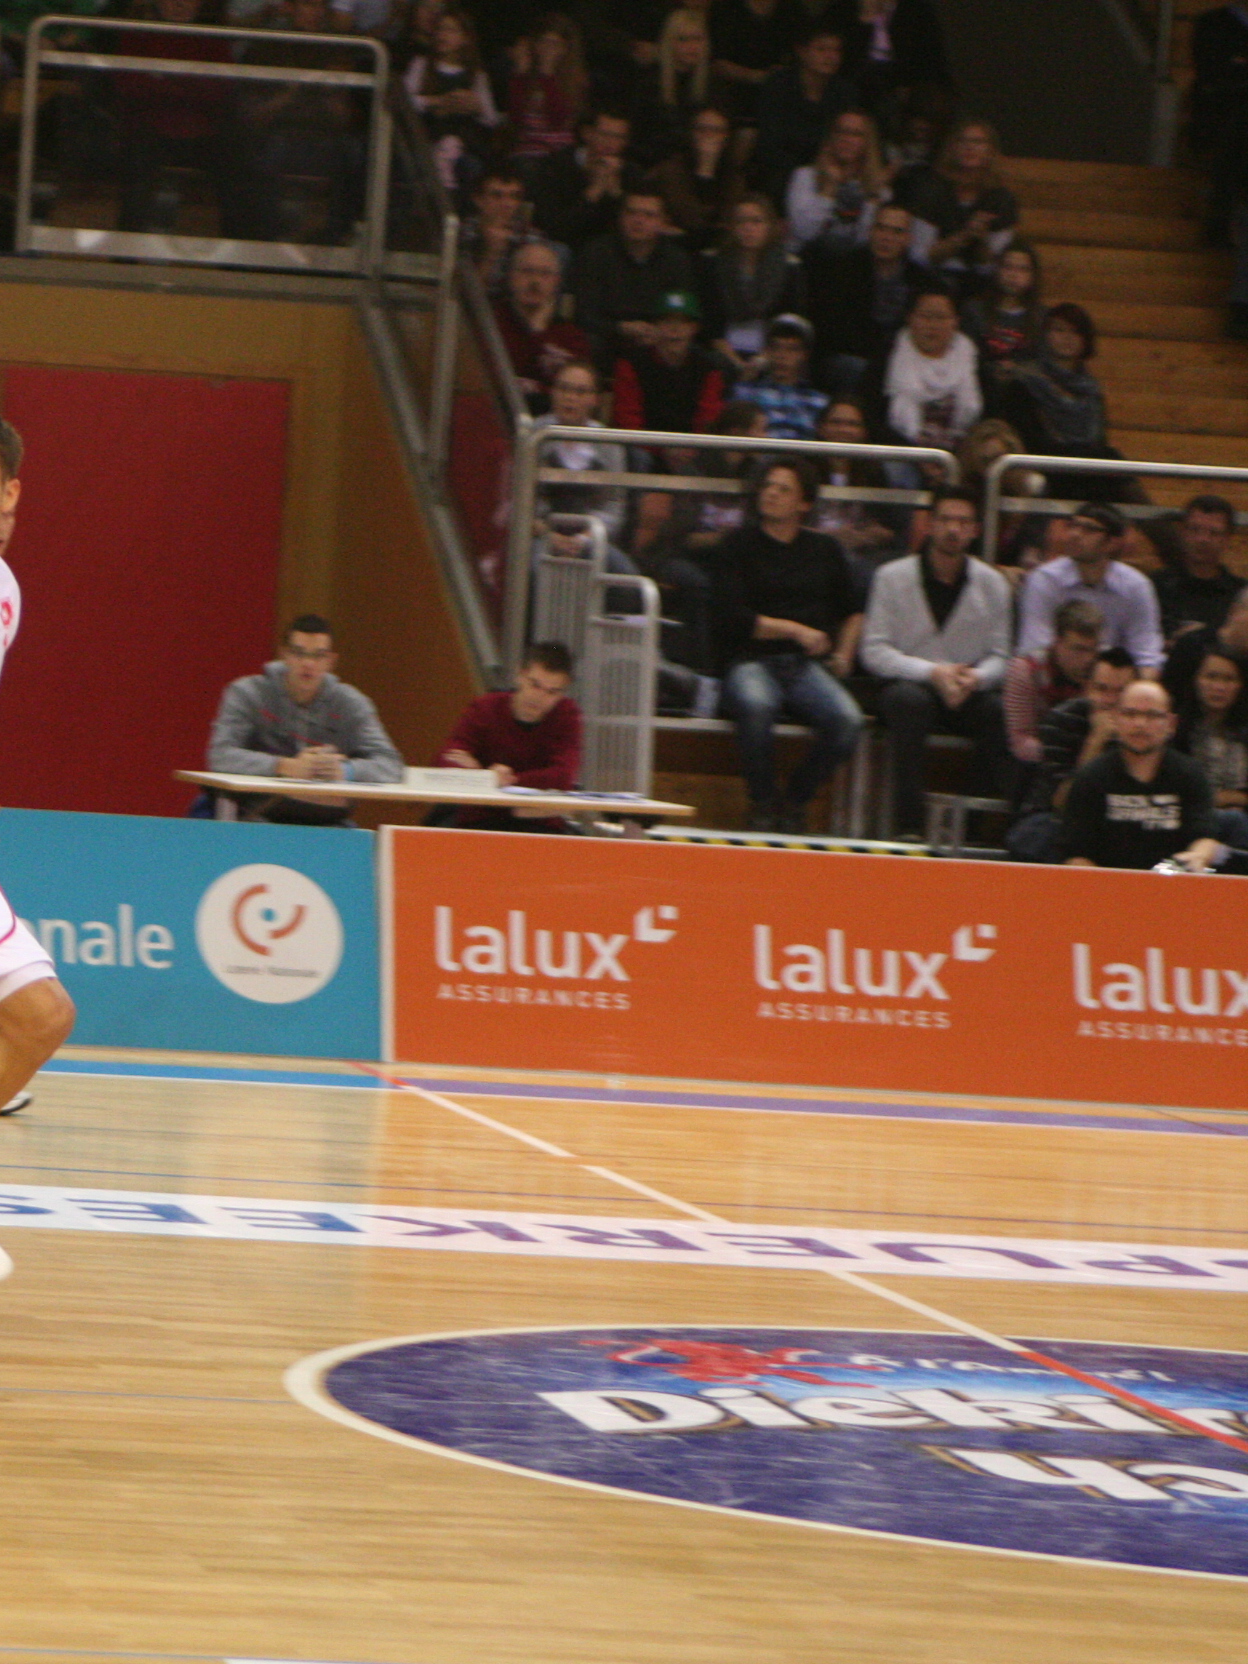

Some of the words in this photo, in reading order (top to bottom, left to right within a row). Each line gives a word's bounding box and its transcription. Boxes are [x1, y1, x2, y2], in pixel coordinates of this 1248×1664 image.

[434, 905, 632, 982] lalux
[753, 924, 951, 1001] lalux
[436, 983, 632, 1011] ASSURANCES
[756, 1002, 951, 1029] ASSURANCES
